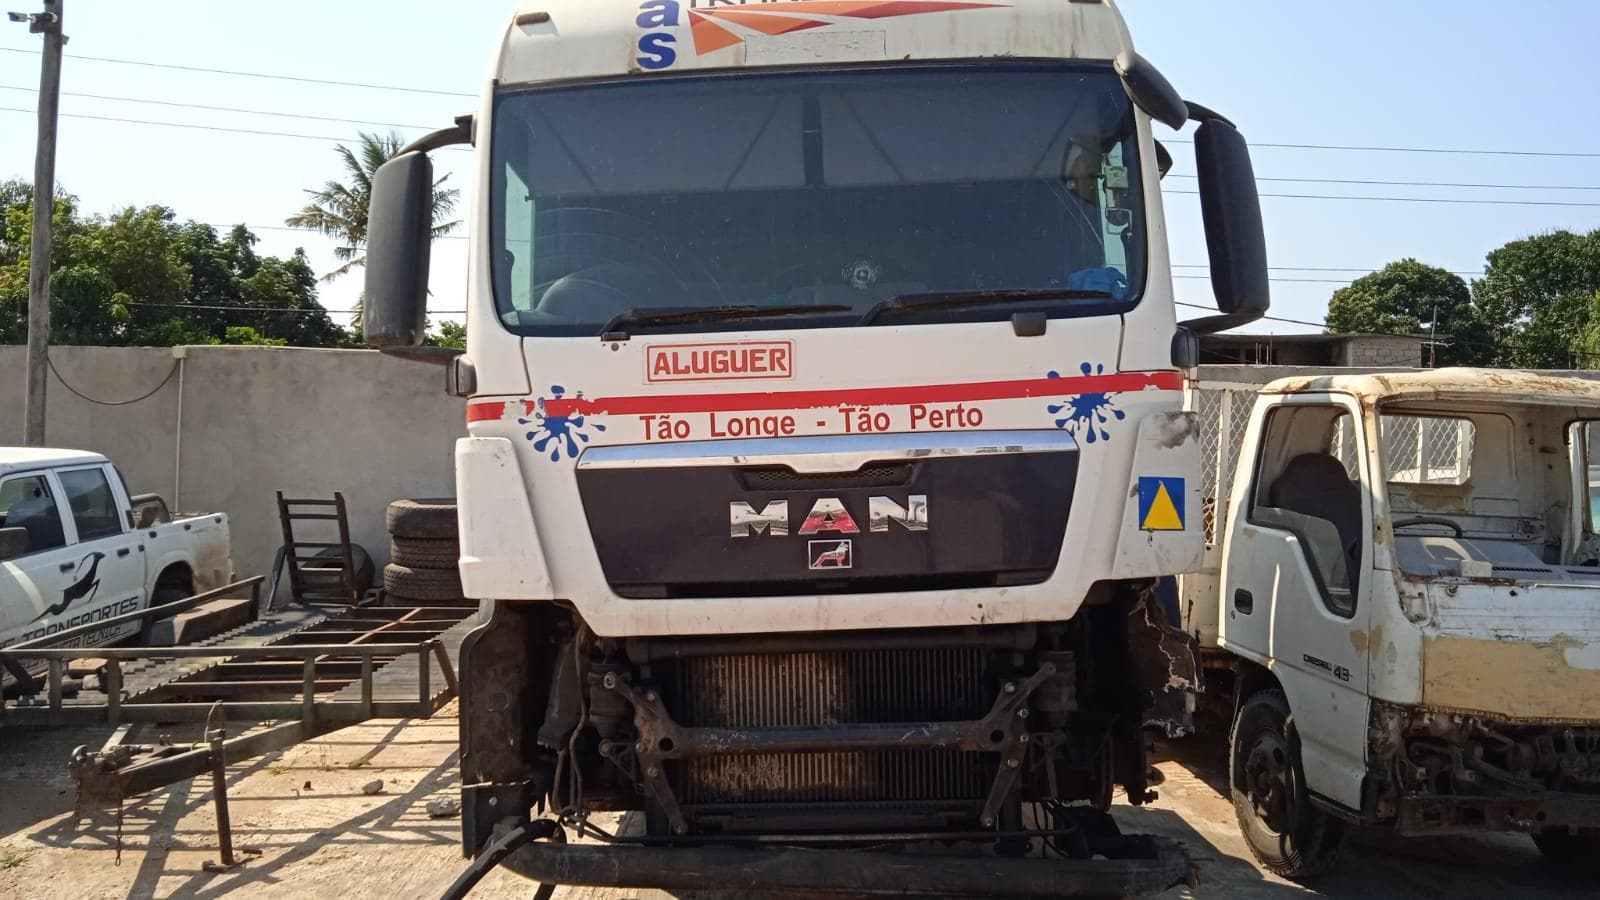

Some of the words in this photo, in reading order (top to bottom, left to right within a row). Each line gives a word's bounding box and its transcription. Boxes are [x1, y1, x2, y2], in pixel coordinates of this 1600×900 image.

[653, 347, 788, 376] ALUGUER
[640, 414, 690, 440] Tão
[709, 410, 796, 438] Longe
[838, 405, 891, 433] Tão
[909, 401, 984, 430] Perto
[729, 494, 929, 538] MAN
